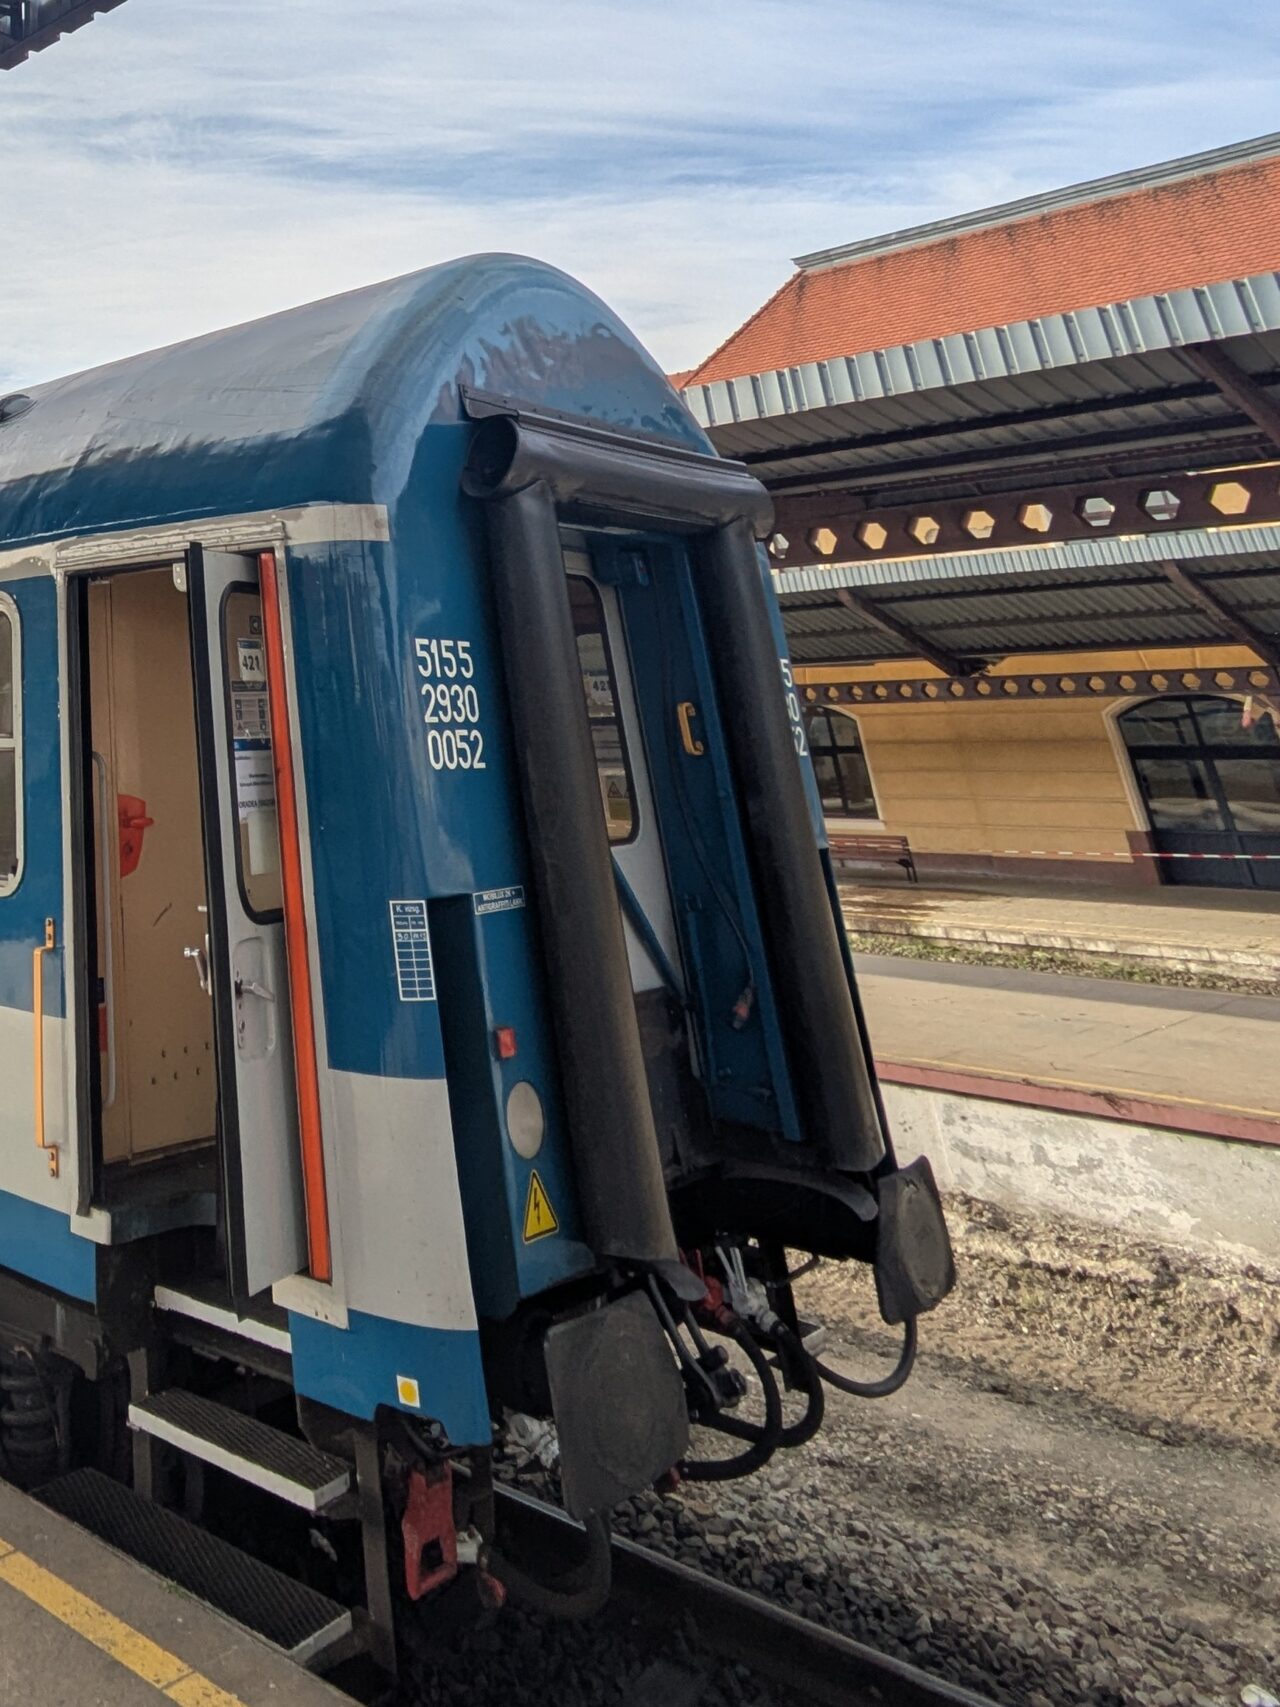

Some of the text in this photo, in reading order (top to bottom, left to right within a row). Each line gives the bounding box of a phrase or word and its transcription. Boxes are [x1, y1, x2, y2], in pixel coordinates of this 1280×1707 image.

[242, 655, 260, 671] 421
[415, 637, 474, 679] 5155
[421, 683, 480, 723] 2930
[427, 729, 487, 771] 0052
